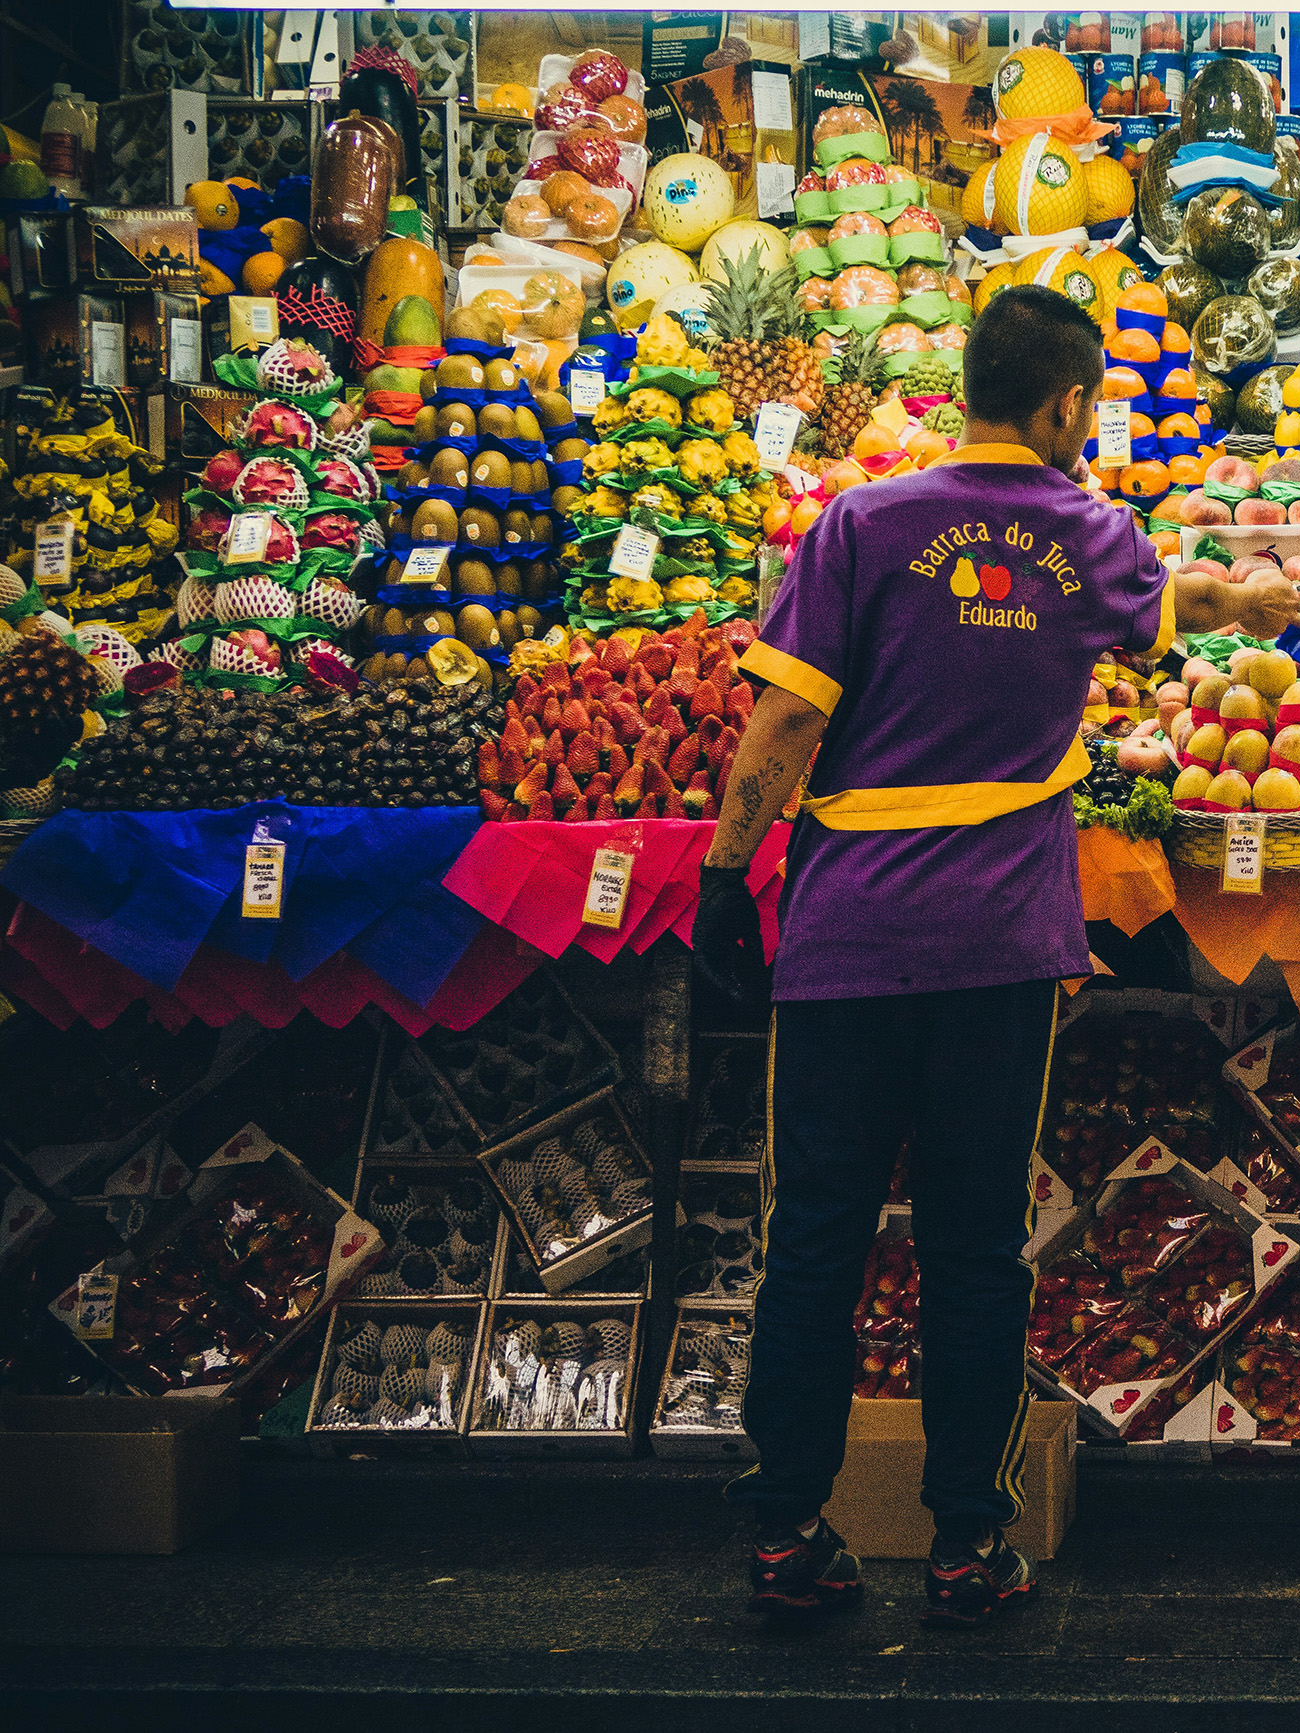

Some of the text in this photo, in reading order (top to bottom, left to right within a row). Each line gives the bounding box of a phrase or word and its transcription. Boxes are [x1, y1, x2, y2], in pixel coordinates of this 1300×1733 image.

[814, 86, 864, 103] mehadrin
[100, 208, 194, 223] MEDJOUL DATES
[613, 289, 633, 303] Dino
[190, 387, 237, 400] MEDJOUL
[909, 522, 991, 579] Barraca
[1005, 521, 1034, 551] do
[959, 600, 1037, 631] Eduardo
[594, 871, 625, 886] MORANGO
[601, 884, 622, 895] EXTRA
